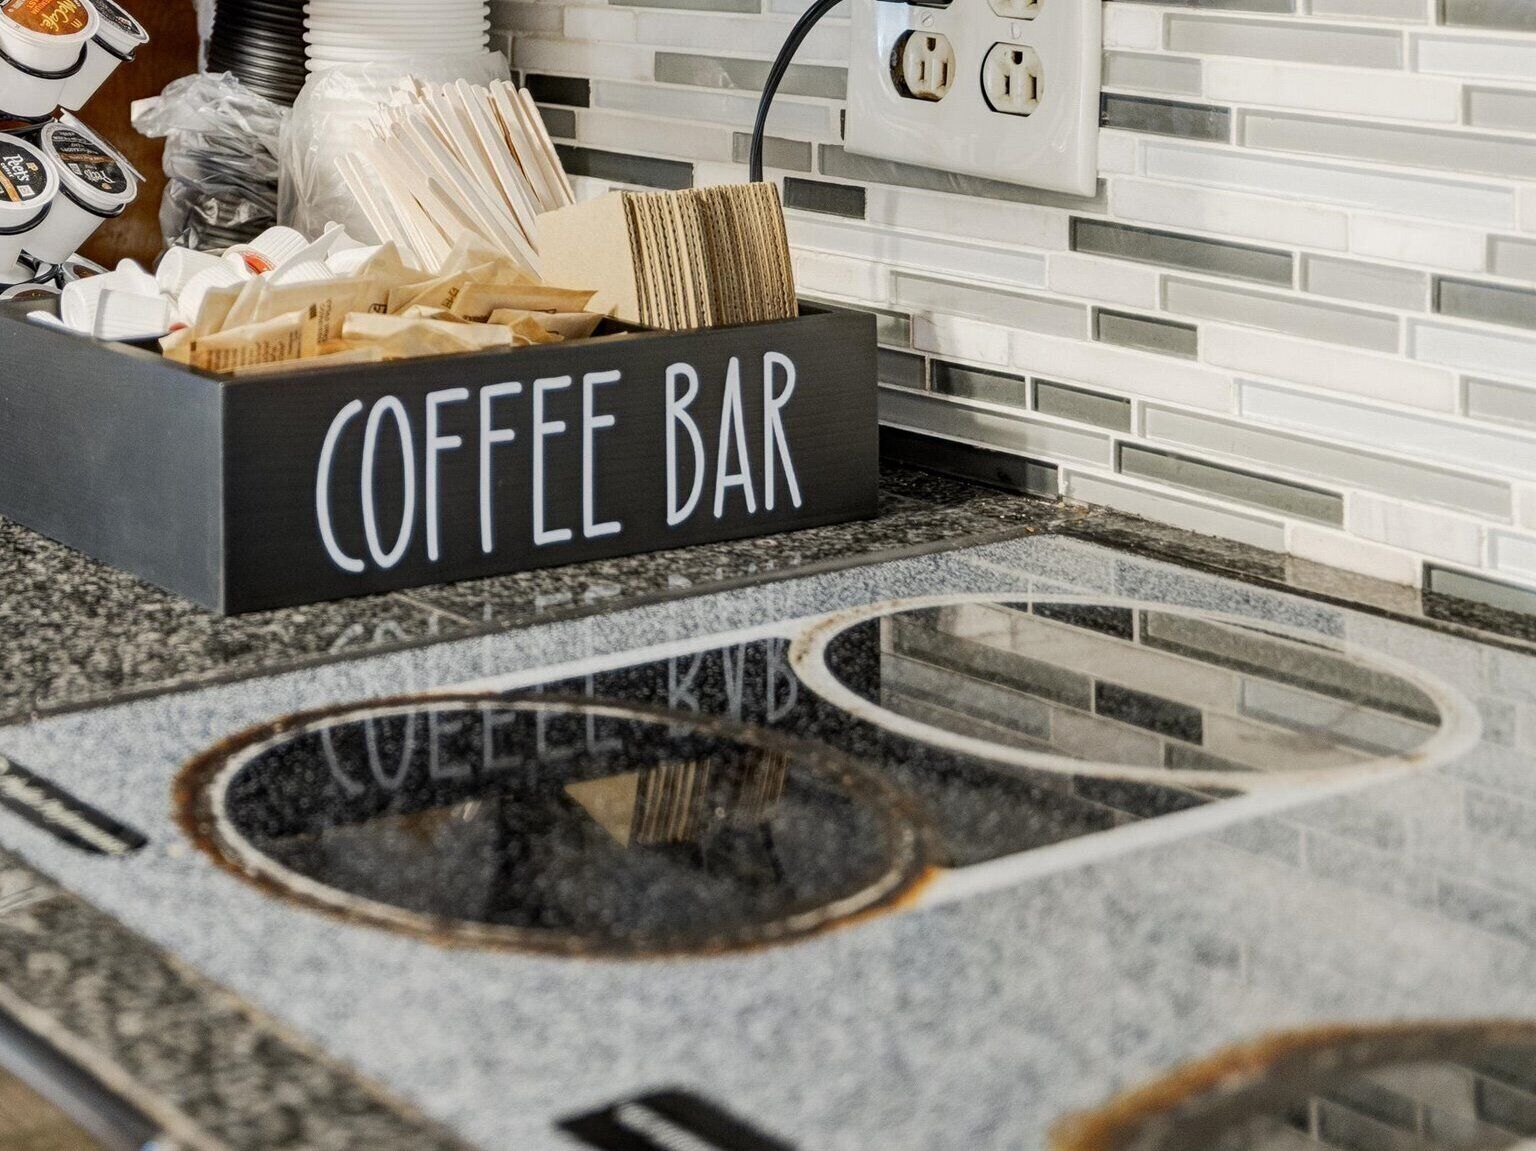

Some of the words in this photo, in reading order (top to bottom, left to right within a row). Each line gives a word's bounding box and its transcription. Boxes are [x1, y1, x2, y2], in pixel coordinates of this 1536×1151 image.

[3, 153, 30, 182] Peet's
[315, 369, 622, 572] COFFEE
[665, 351, 802, 526] BAR
